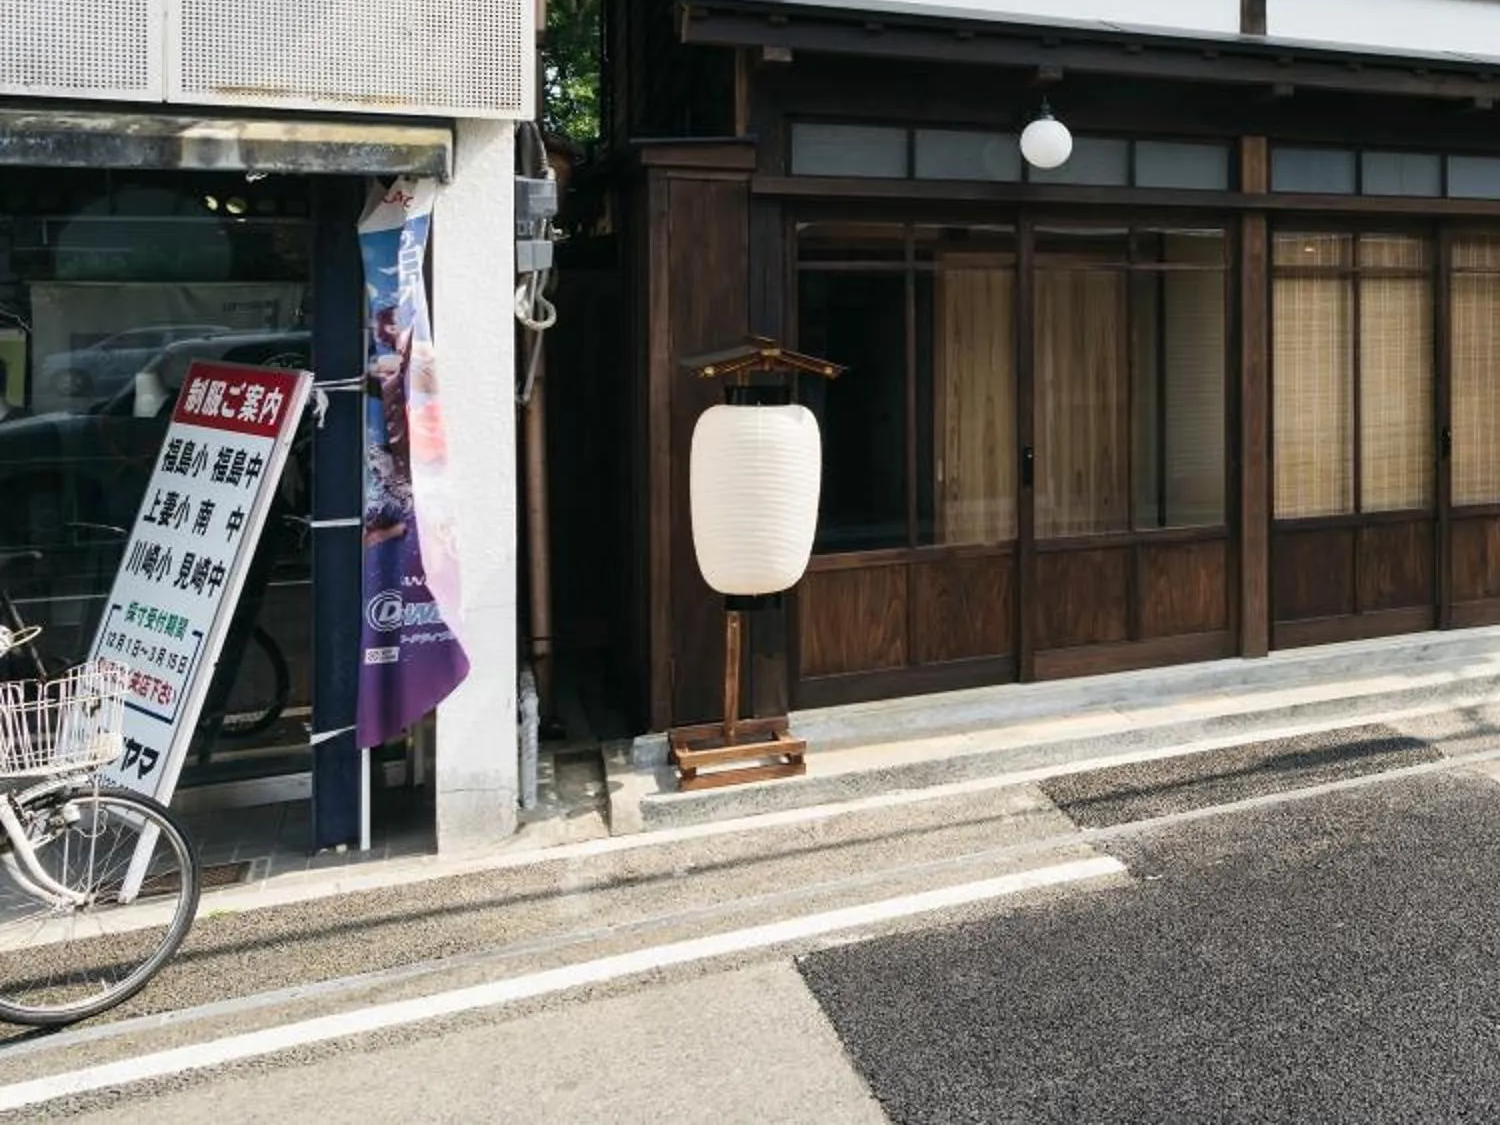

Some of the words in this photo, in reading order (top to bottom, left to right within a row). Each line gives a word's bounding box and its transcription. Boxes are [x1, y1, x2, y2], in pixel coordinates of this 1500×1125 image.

[183, 377, 284, 427] 制服ご案内
[161, 437, 209, 478] 福島小
[210, 446, 264, 489] 福島中
[125, 539, 173, 582] 川崎小
[173, 551, 227, 598] 見崎中
